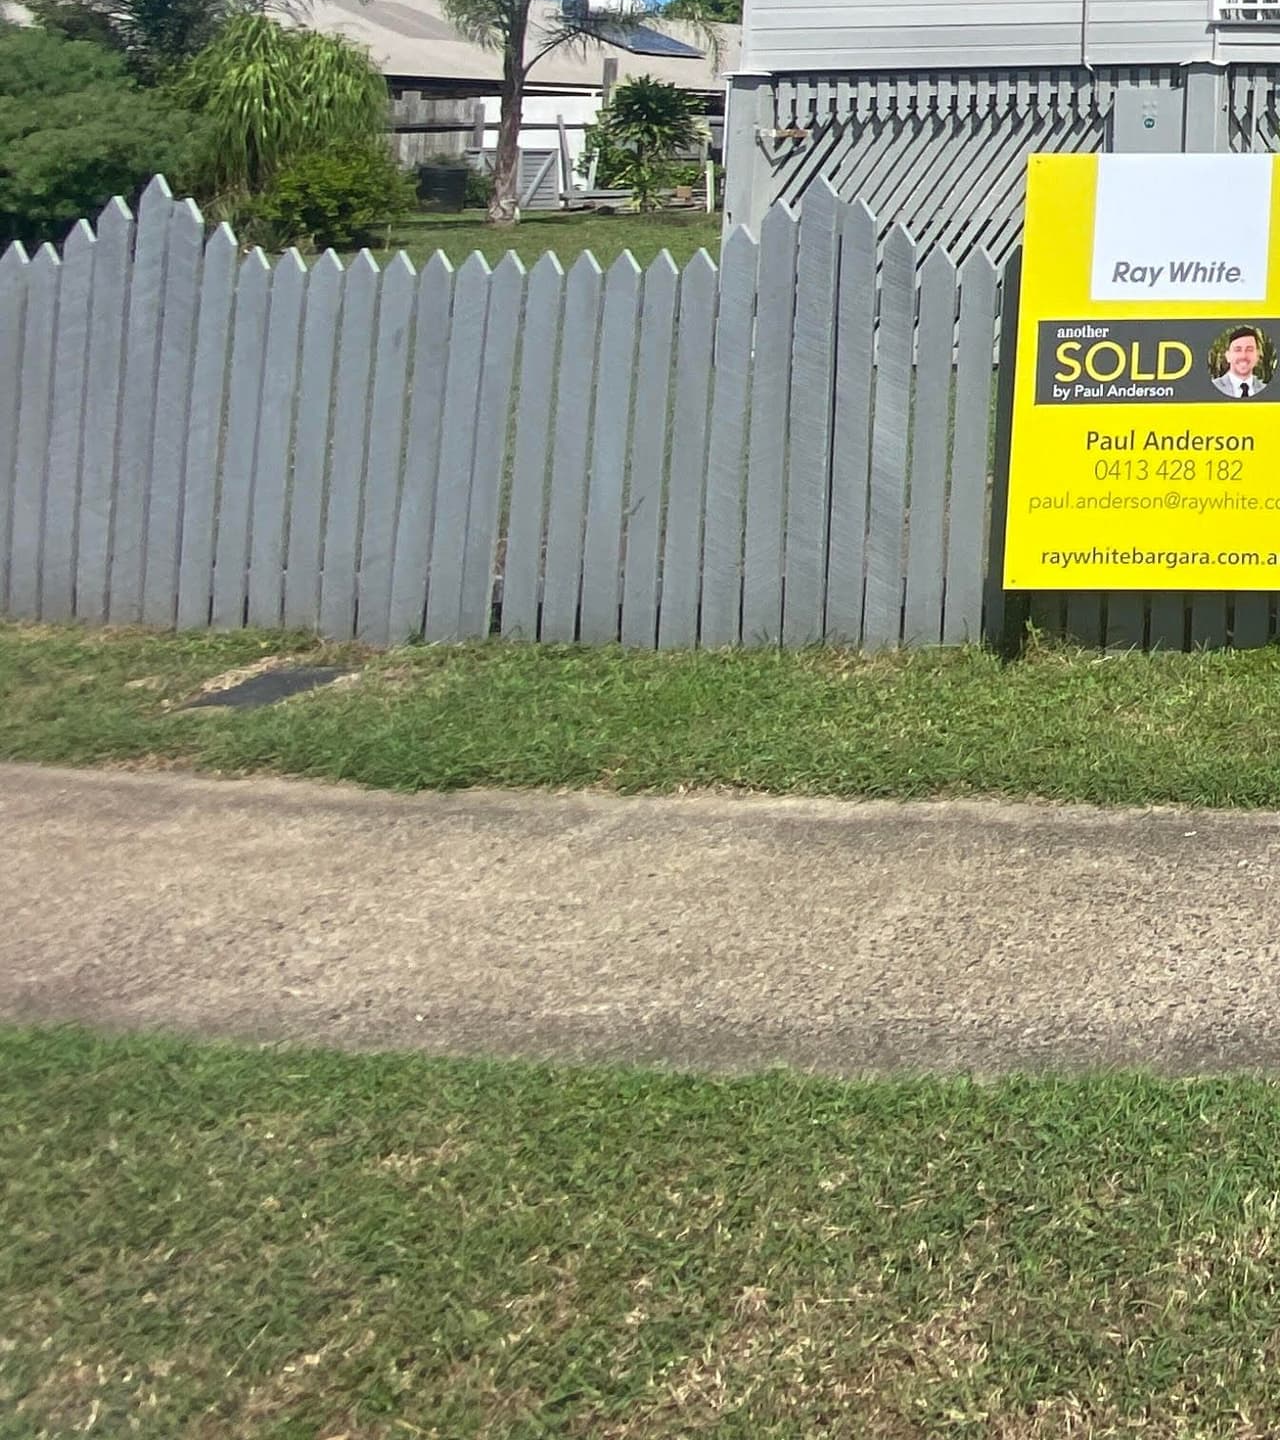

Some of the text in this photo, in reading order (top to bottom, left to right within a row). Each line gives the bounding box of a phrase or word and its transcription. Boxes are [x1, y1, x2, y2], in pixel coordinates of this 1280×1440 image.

[1112, 261, 1241, 287] Ray White
[1057, 325, 1110, 338] another
[1054, 340, 1194, 382] SOLD
[1053, 384, 1174, 400] by Paul Anderson
[1086, 430, 1255, 451] Paul Anderson
[1094, 459, 1244, 481] 0413 428 182
